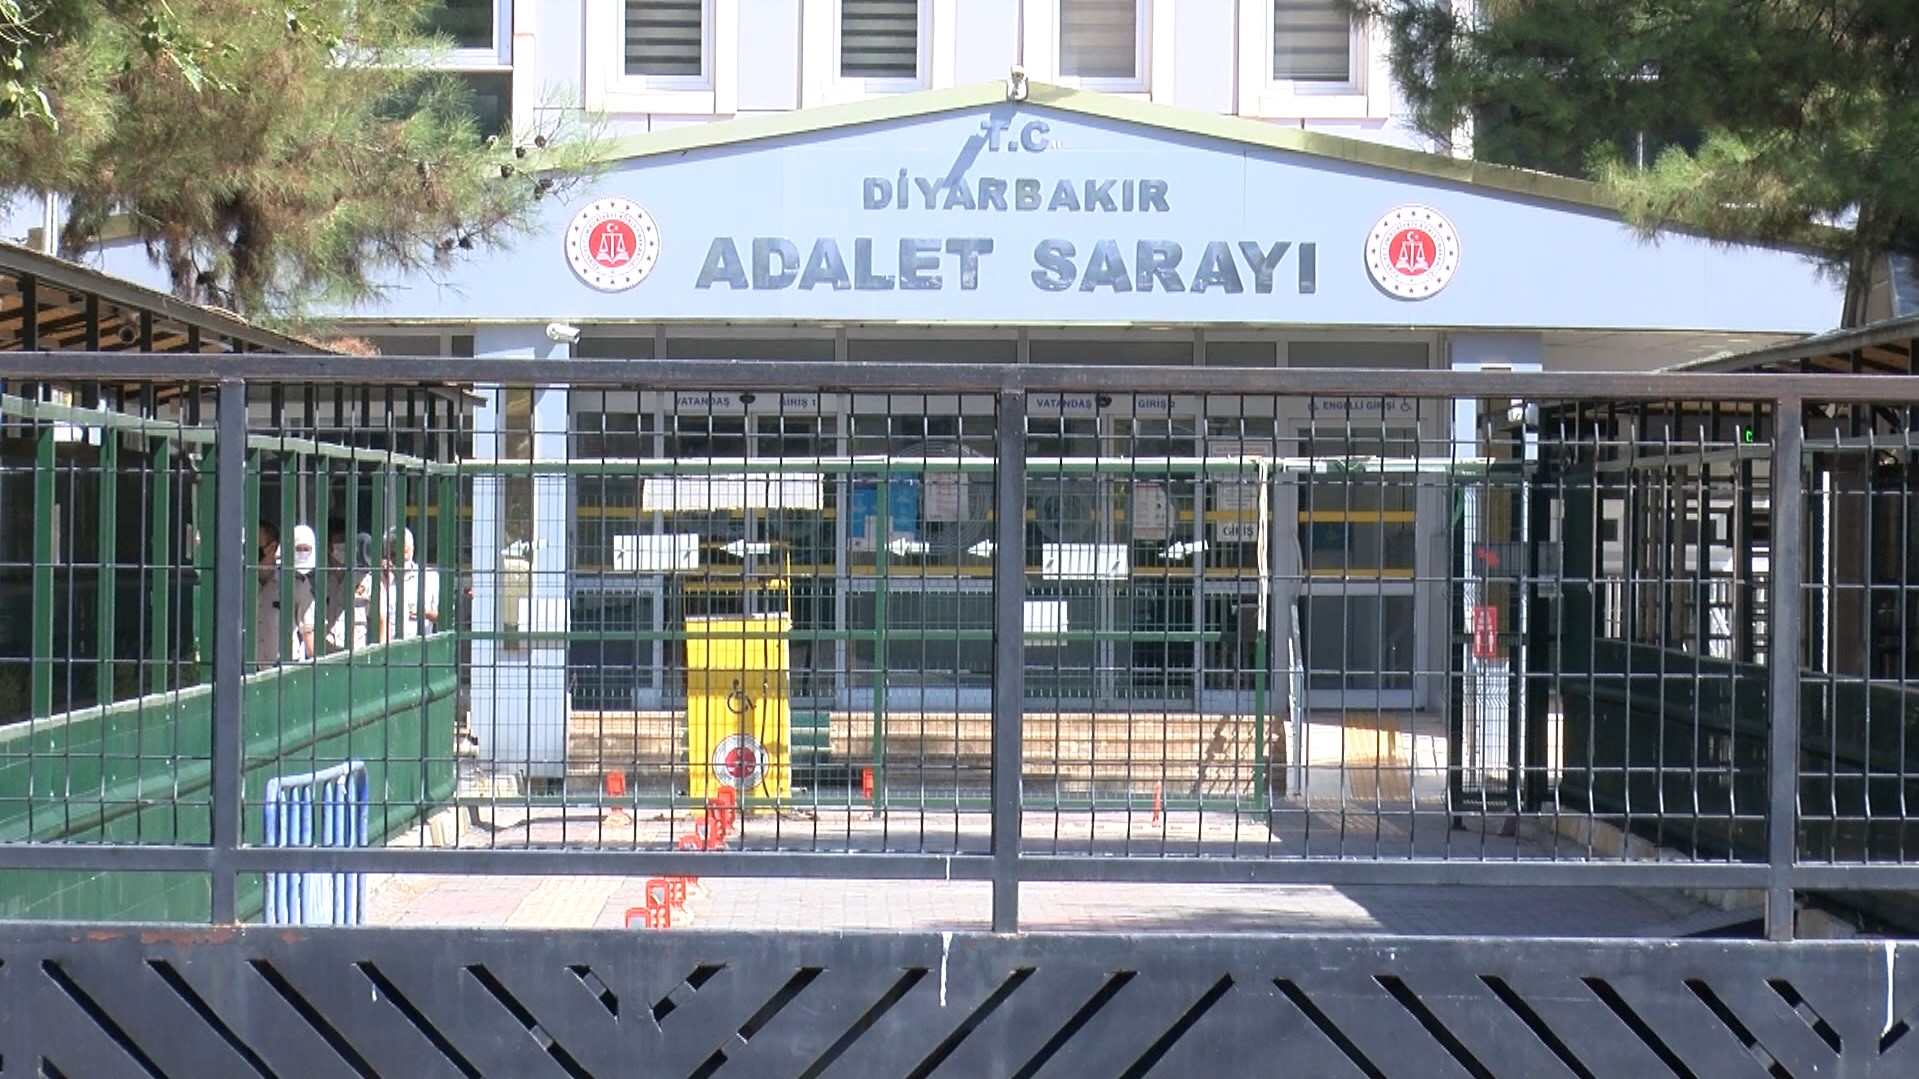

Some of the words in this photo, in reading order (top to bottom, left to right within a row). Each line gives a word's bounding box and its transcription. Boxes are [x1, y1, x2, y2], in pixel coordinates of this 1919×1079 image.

[862, 167, 1171, 212] DİYARBAKIR
[695, 236, 994, 291] ADALET
[1030, 238, 1317, 295] SARAYI
[1036, 398, 1092, 410] VATANDAŞ
